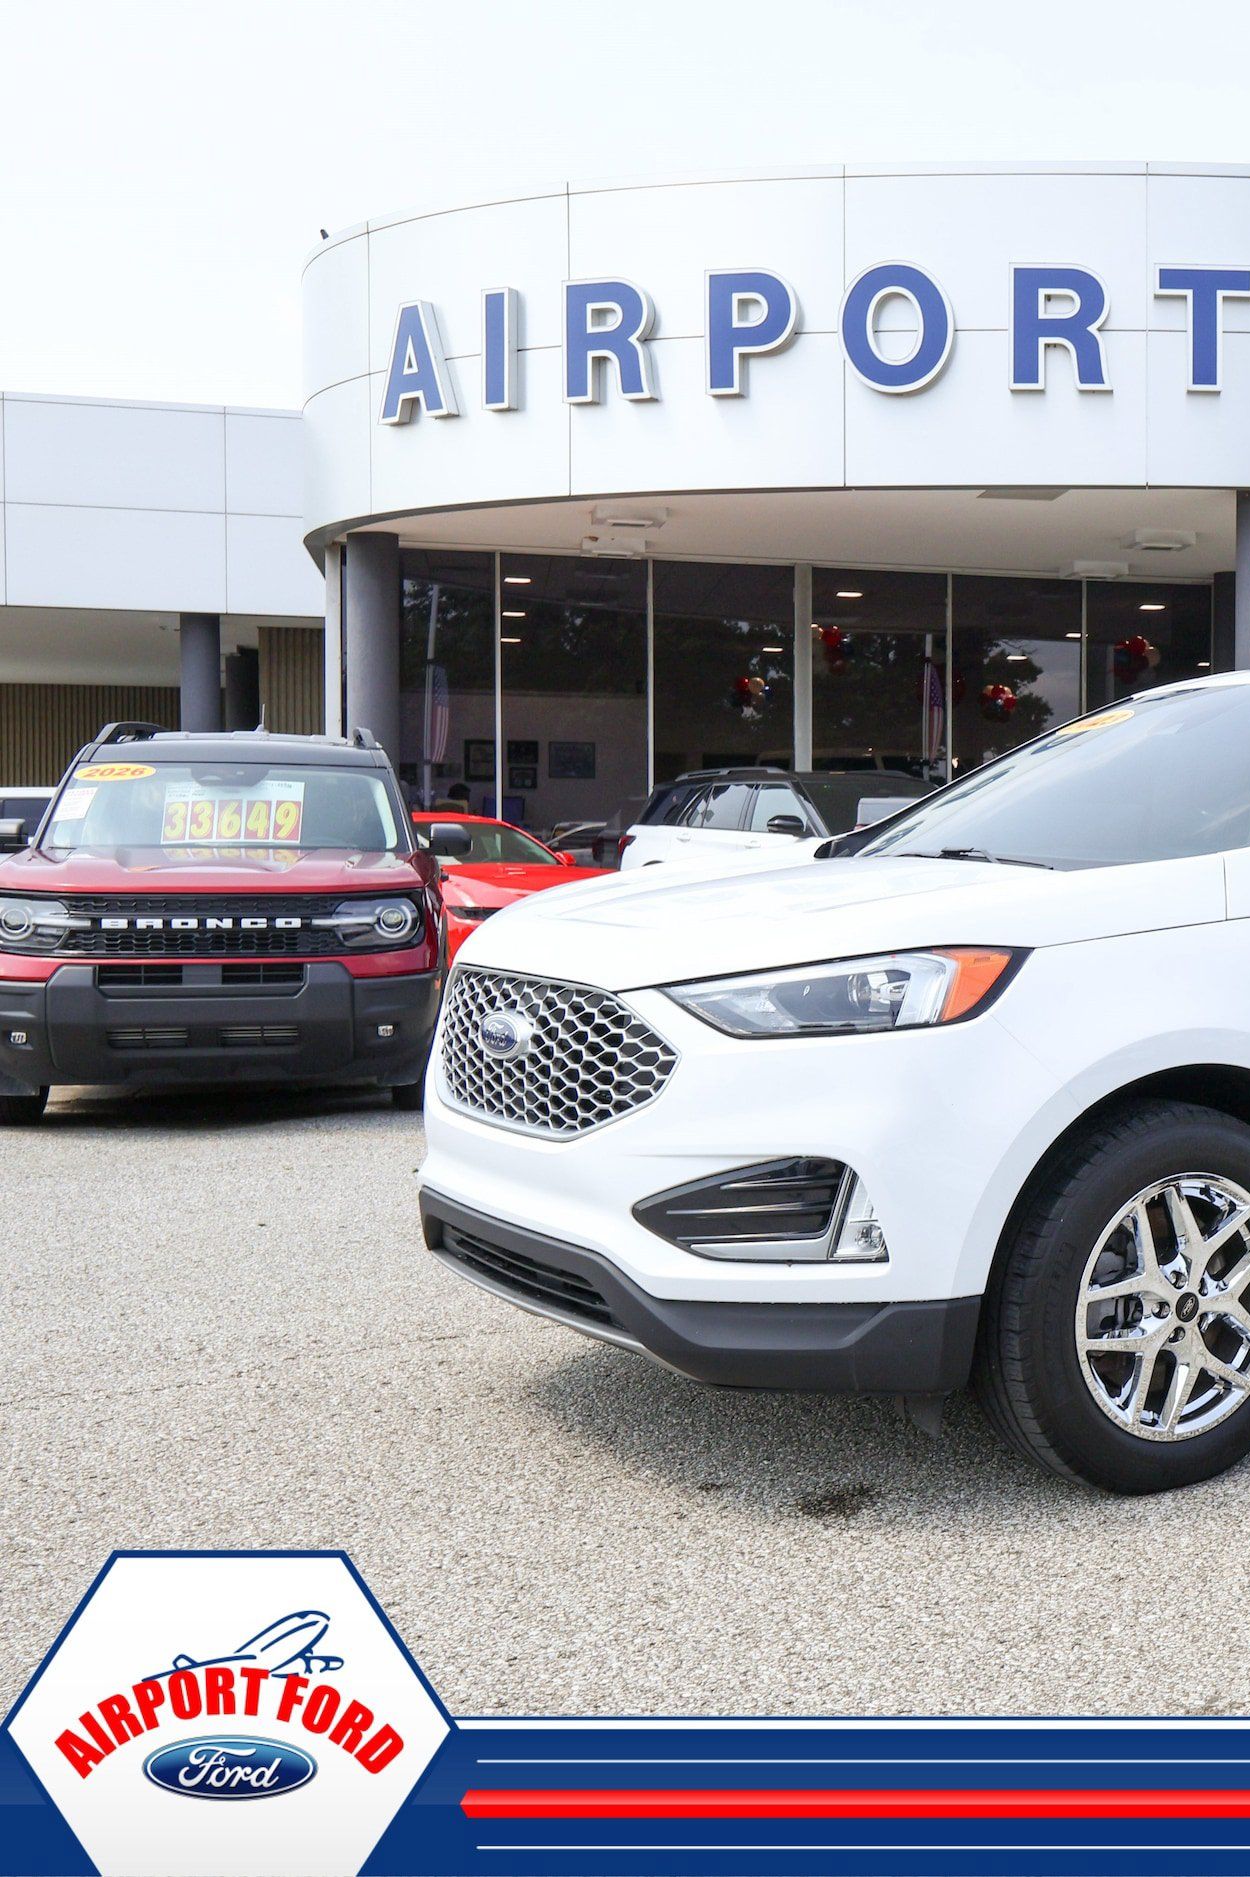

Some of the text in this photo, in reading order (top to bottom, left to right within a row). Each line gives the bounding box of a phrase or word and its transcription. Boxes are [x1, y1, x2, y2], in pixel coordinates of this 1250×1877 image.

[83, 768, 147, 778] 2026
[164, 801, 299, 839] 33649
[101, 917, 302, 929] BRONCO
